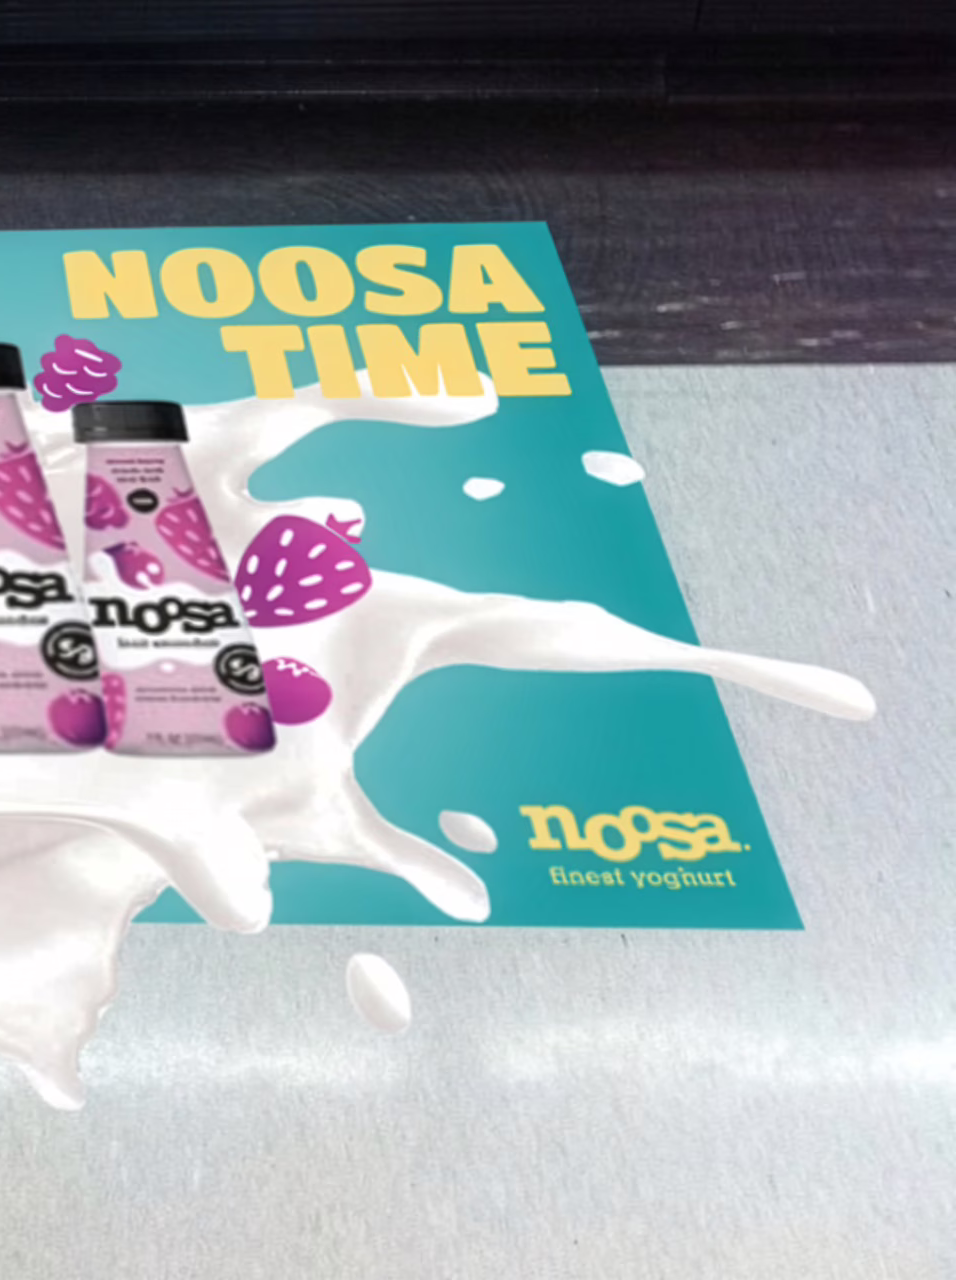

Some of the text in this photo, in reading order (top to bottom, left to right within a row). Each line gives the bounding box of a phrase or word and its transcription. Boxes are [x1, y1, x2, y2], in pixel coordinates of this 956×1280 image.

[62, 244, 545, 318] NOOSA
[220, 321, 572, 399] TIME
[88, 596, 241, 634] noosa
[548, 866, 737, 890] finest yoghurt
